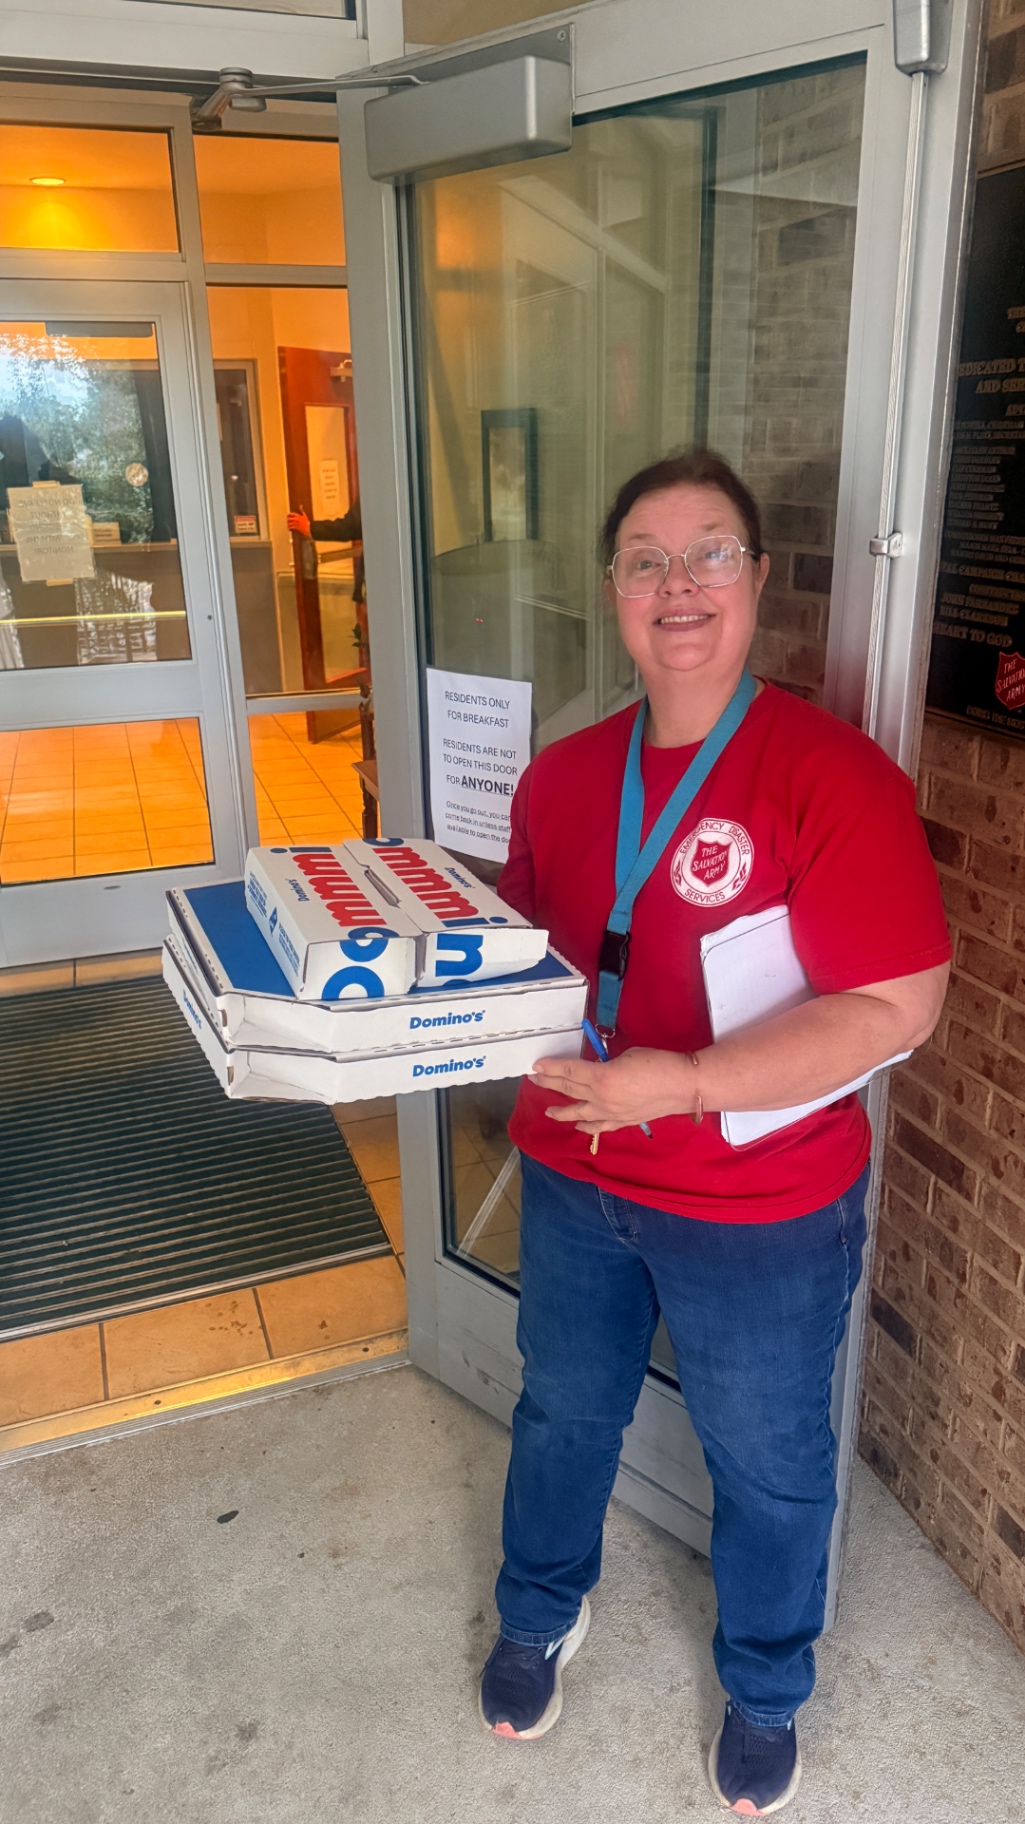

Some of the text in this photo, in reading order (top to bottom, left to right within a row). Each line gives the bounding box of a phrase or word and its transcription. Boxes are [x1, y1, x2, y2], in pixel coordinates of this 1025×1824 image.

[956, 358, 1018, 377] EDICATED
[969, 628, 986, 643] TO
[987, 632, 1013, 648] GOD
[1004, 658, 1018, 675] THE
[996, 668, 1025, 693] SALVATIO
[445, 690, 510, 709] RESIDENTS ONLY
[447, 709, 509, 728] FOR BREAKFAST
[443, 738, 516, 759] RESIDENTS ARE NOT
[443, 753, 518, 776] TO OPEN THIS DOOR
[446, 774, 514, 796] FOR ANYONE!
[446, 800, 460, 810] Once
[461, 805, 469, 813] you
[469, 807, 477, 815] go
[489, 811, 499, 819] you
[445, 812, 460, 821] come
[460, 815, 472, 825] back
[472, 818, 479, 826] in
[479, 820, 497, 830] unless
[447, 824, 510, 844] available to open the do
[728, 825, 751, 856] DISASTER
[701, 845, 718, 858] THE
[703, 860, 726, 880] ARMY
[684, 888, 726, 903] SERVICES
[409, 1010, 484, 1030] Domino's
[412, 1057, 485, 1077] Domino's
